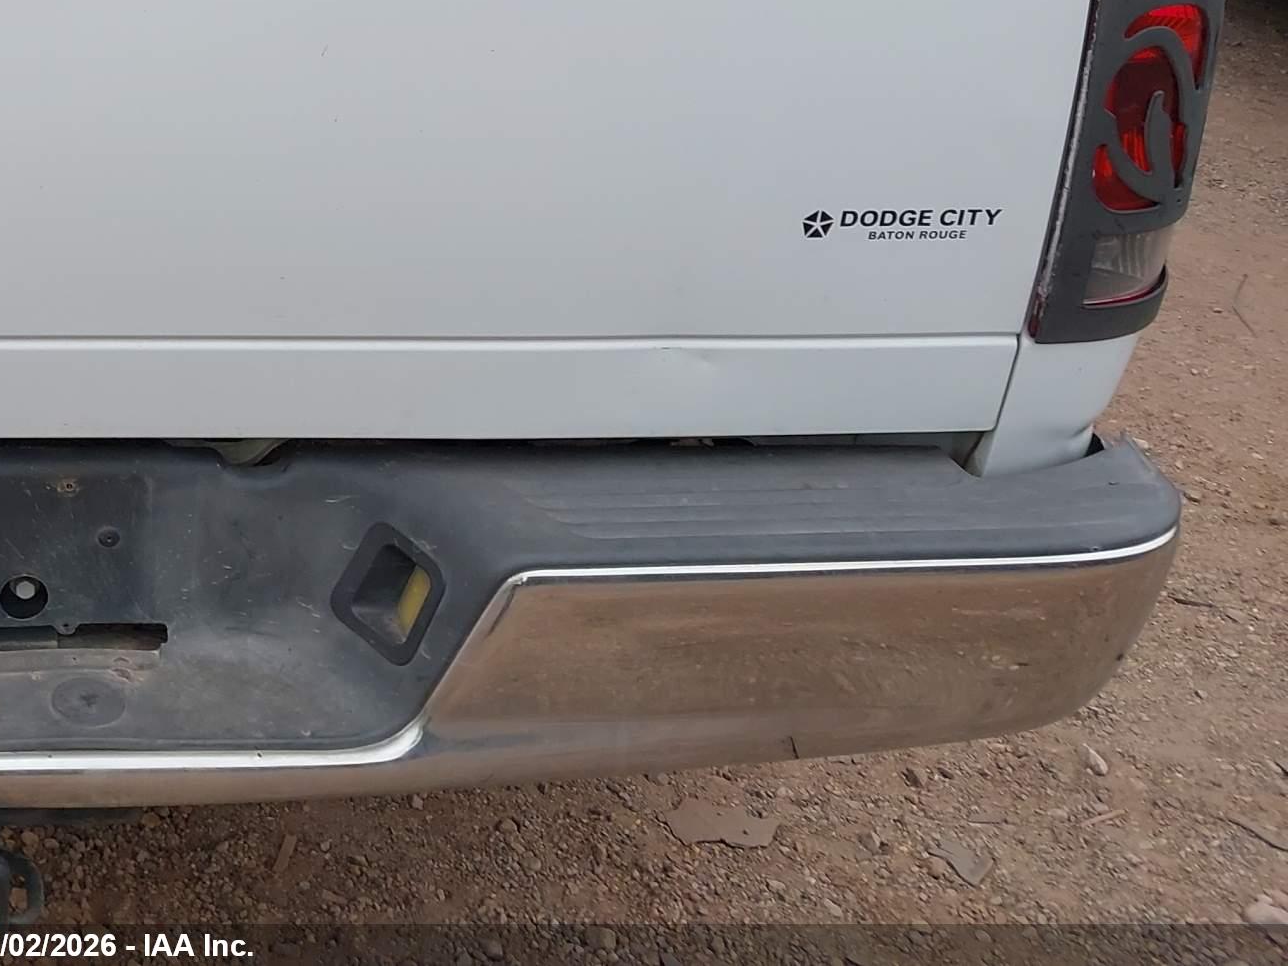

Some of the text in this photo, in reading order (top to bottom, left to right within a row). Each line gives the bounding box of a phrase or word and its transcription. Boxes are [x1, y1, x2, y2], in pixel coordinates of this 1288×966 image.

[840, 208, 1003, 227] DODGE CITY
[868, 230, 967, 240] BATON ROUGE
